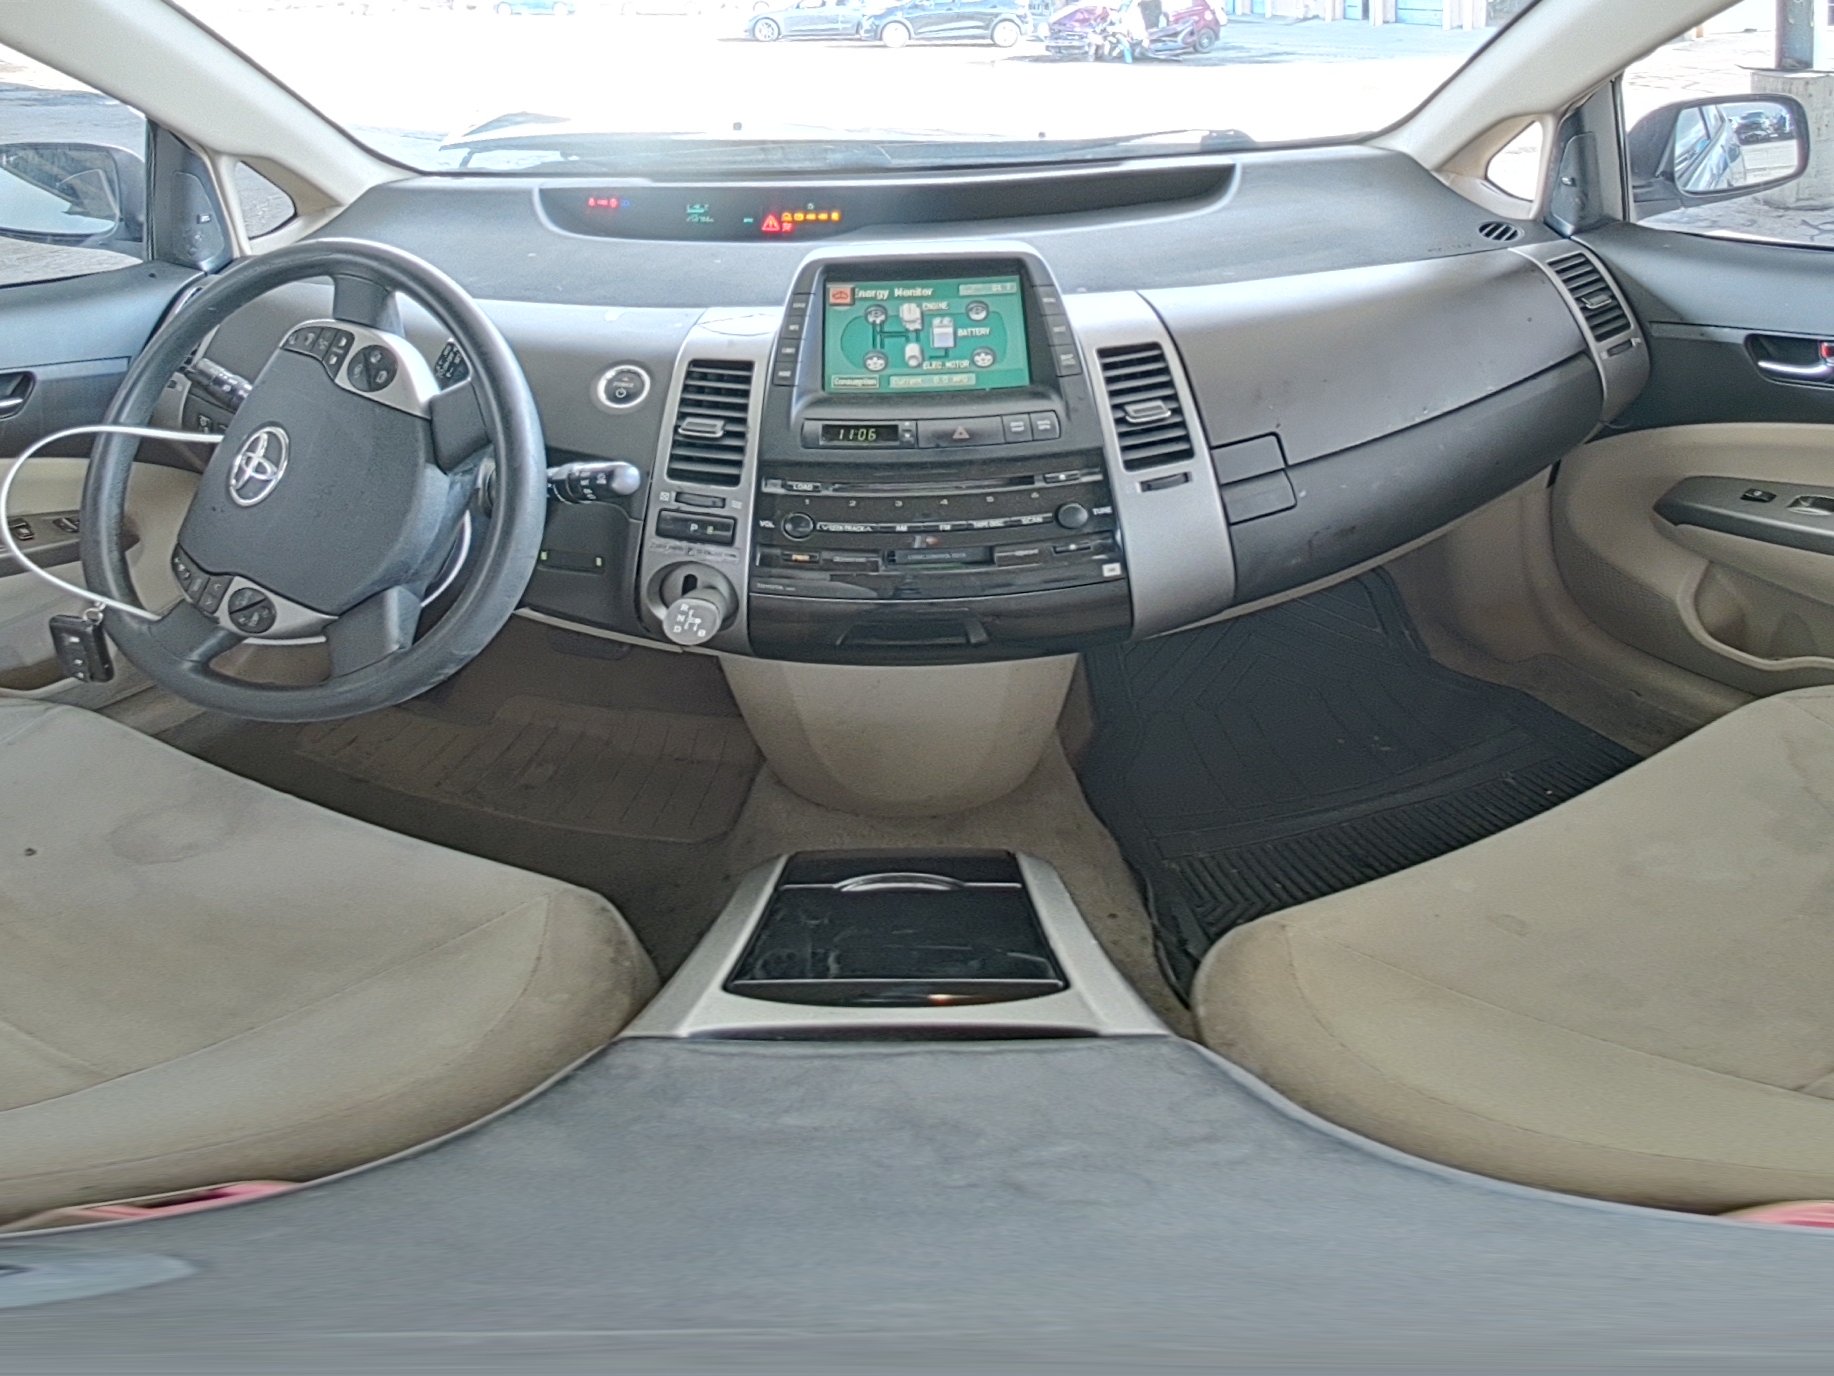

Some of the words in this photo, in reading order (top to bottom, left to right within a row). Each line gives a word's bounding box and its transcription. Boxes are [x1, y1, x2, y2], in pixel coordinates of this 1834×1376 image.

[894, 287, 934, 298] Monitor
[922, 301, 949, 311] ENGINE
[957, 327, 990, 337] BATTERY
[838, 428, 877, 442] 11:06
[793, 483, 813, 491] LOAD
[759, 520, 775, 528] VOL
[677, 614, 686, 622] N
